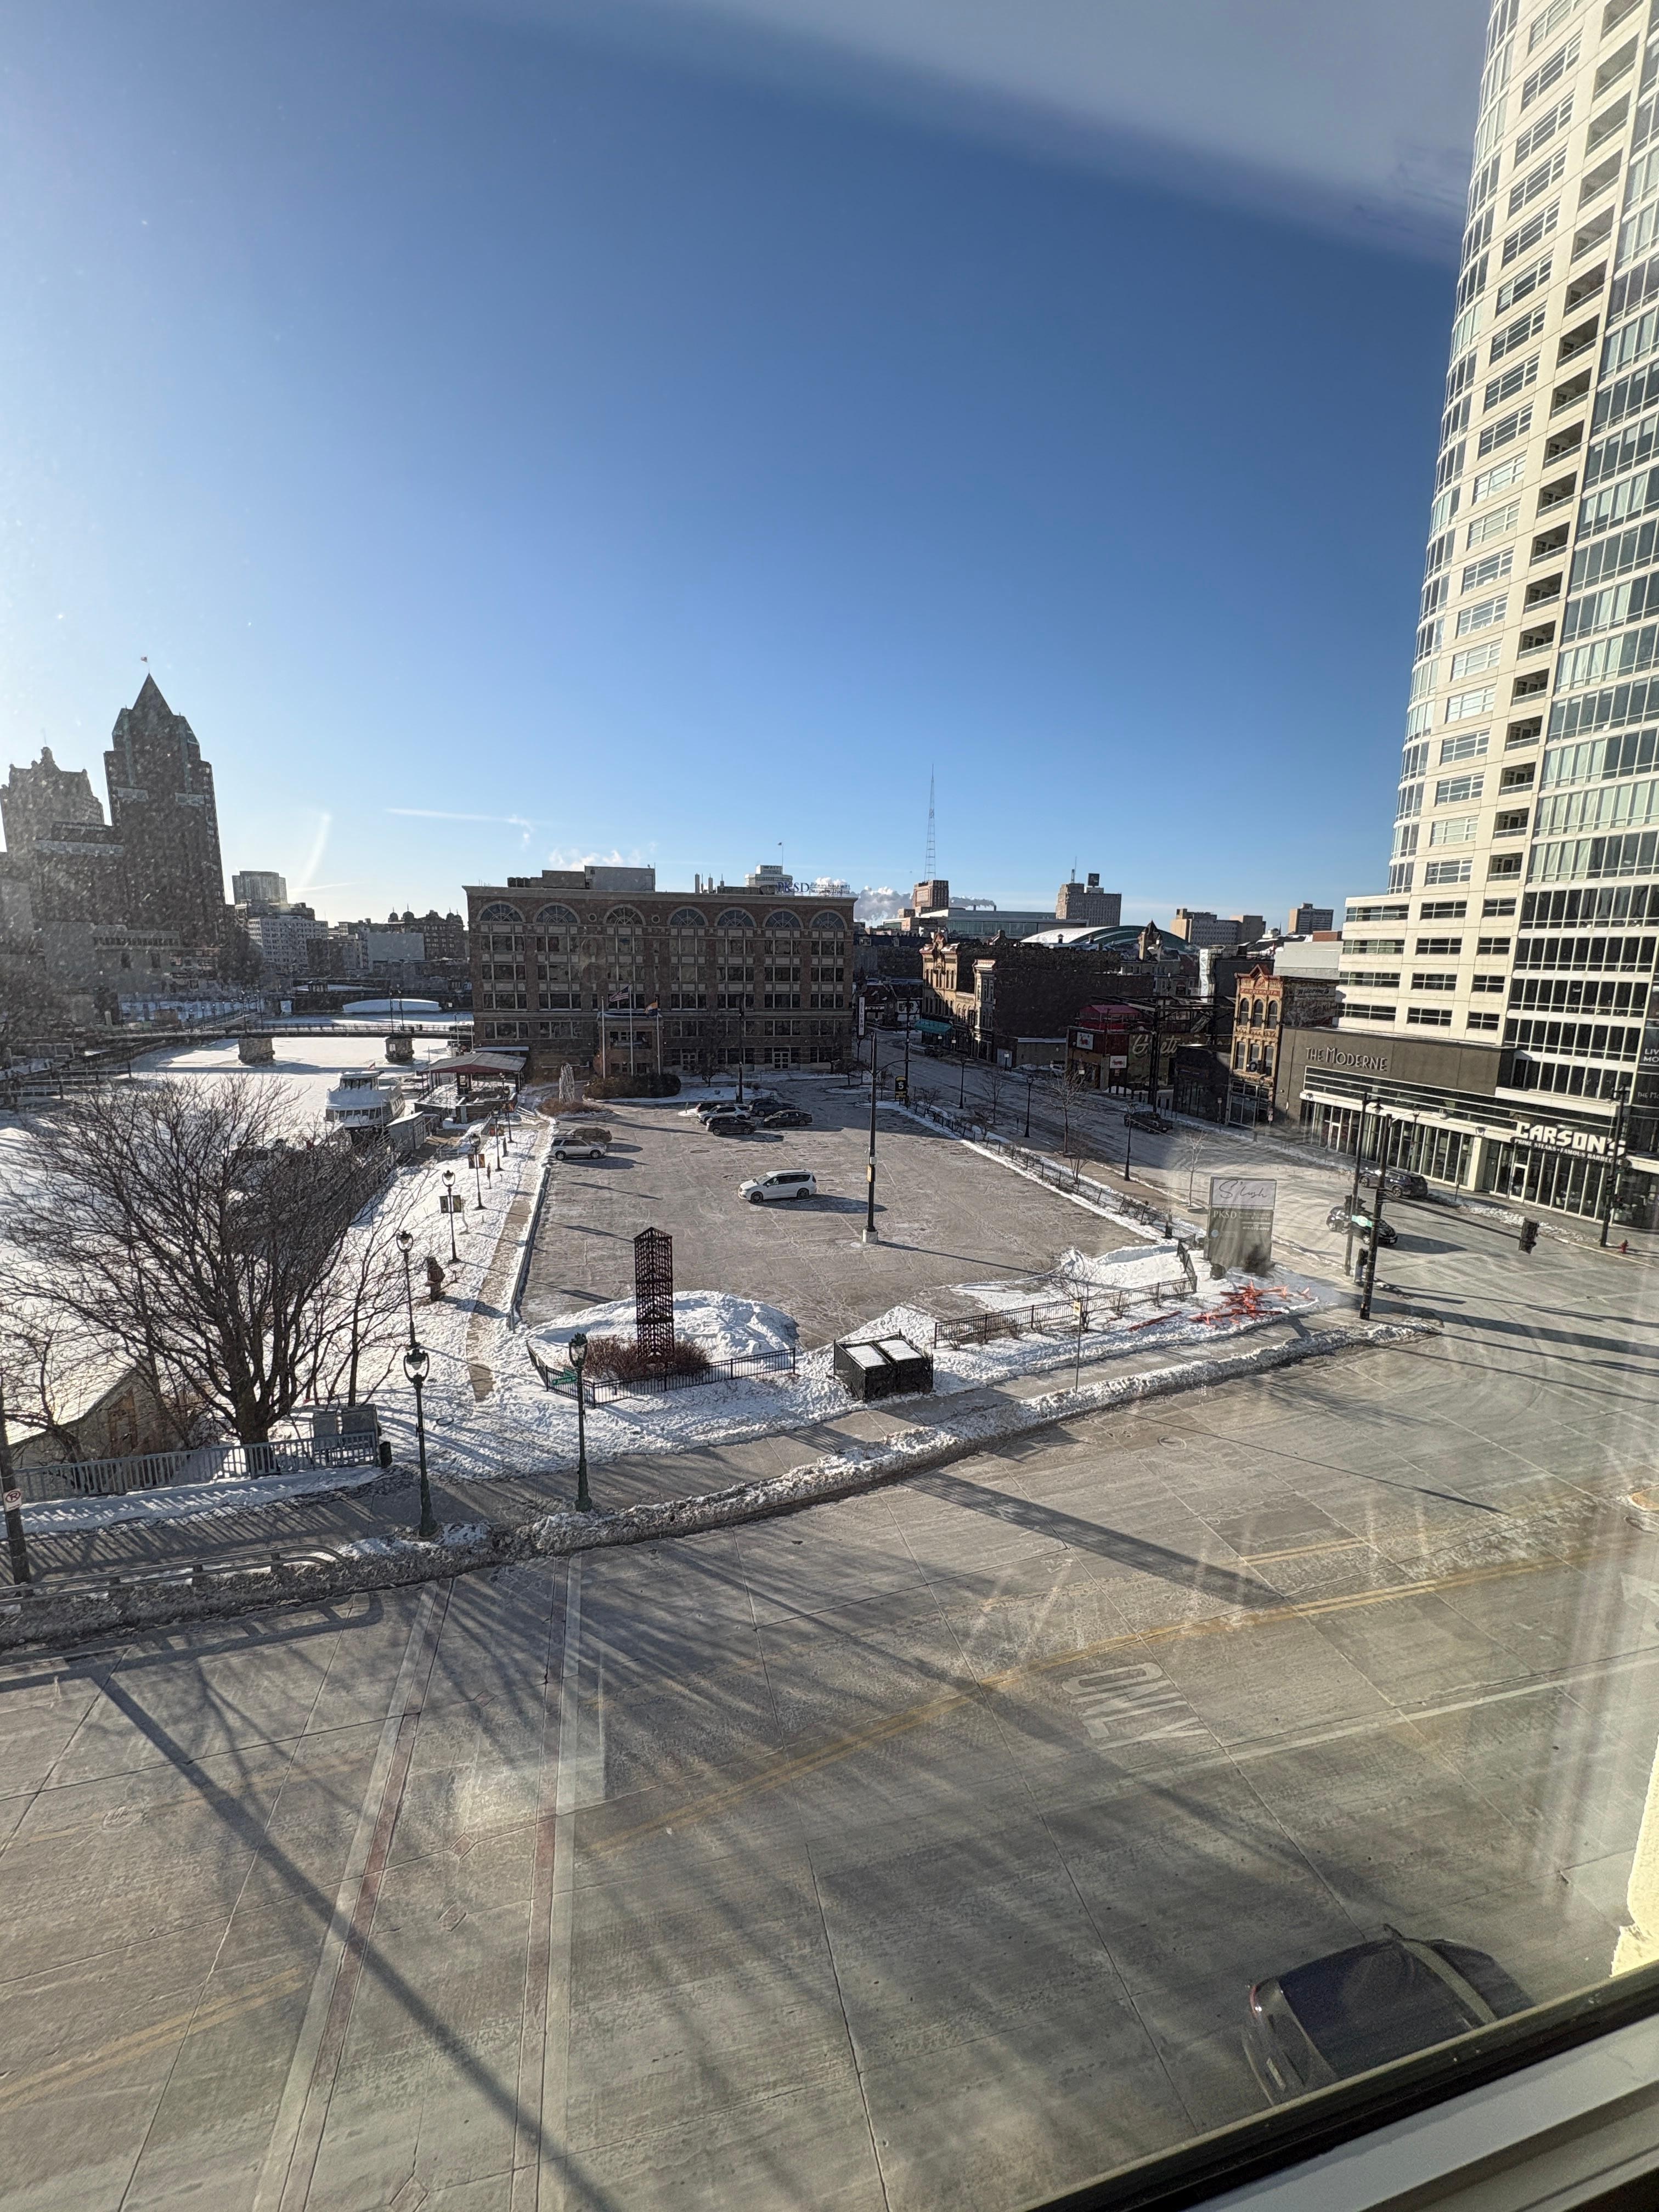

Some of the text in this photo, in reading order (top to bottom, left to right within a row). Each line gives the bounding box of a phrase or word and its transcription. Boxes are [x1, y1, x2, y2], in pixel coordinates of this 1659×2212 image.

[777, 881, 810, 893] PKSD
[1306, 1047, 1387, 1071] THE MODERNE
[1516, 1121, 1627, 1156] CARSON'S
[1515, 1138, 1623, 1166] PRIME STEAKS FAMOUS BARBECE
[1213, 1210, 1237, 1219] PKSD
[1061, 1662, 1209, 1751] ONLY
